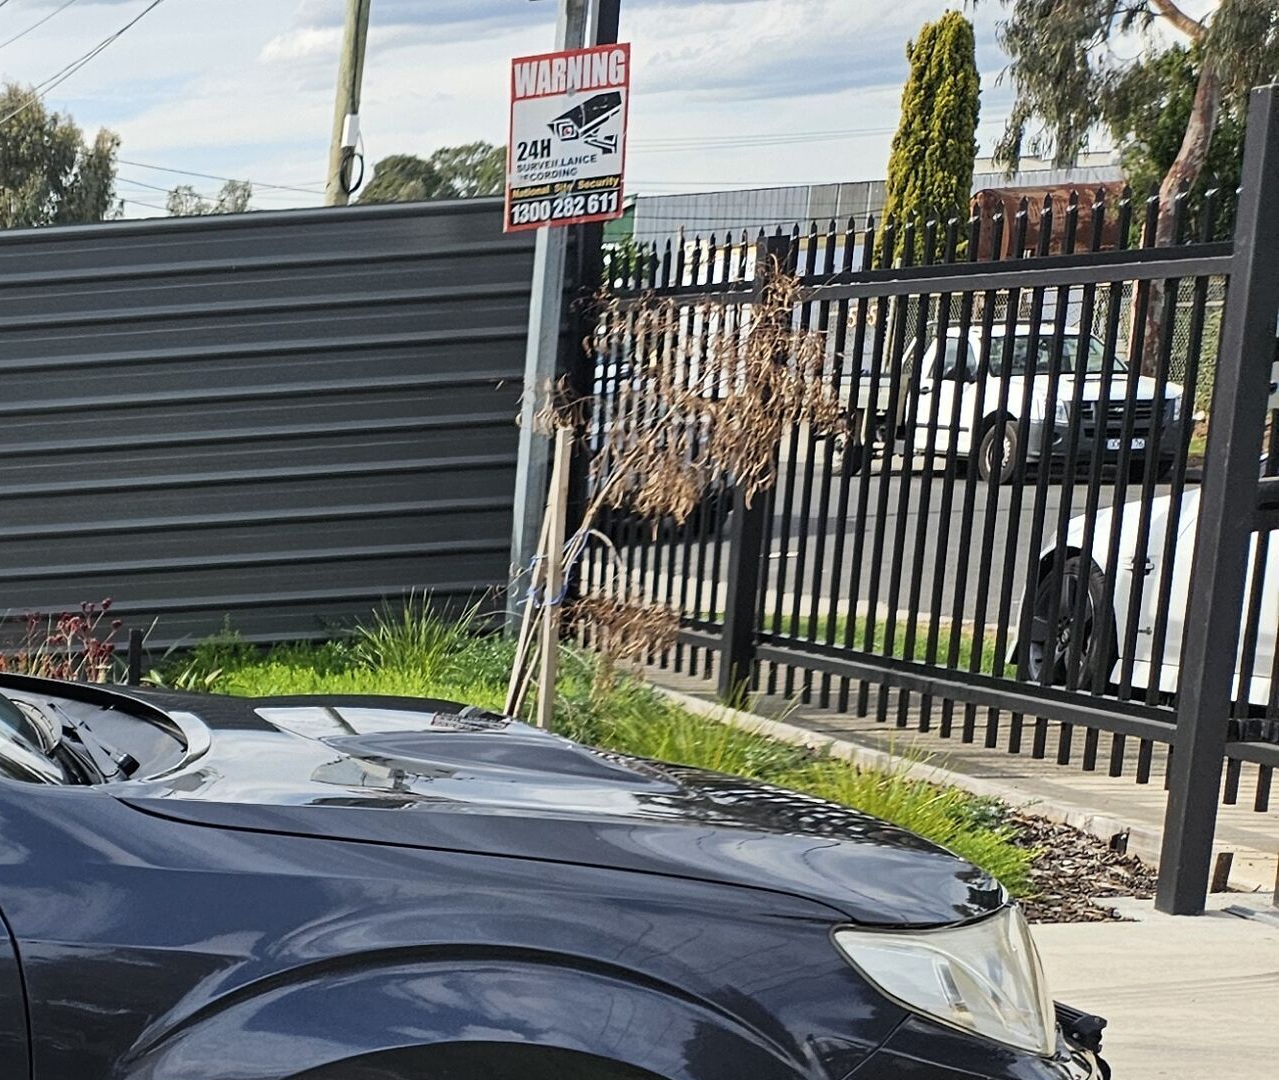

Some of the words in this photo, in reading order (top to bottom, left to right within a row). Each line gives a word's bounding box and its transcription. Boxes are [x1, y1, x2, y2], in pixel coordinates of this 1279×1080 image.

[513, 49, 626, 98] WARNING
[517, 138, 552, 162] 24H
[517, 154, 598, 173] SURVEILLANCE
[512, 185, 550, 199] National
[577, 176, 620, 190] Security
[511, 196, 551, 225] 1300
[551, 193, 585, 220] 282
[587, 191, 619, 216] 611
